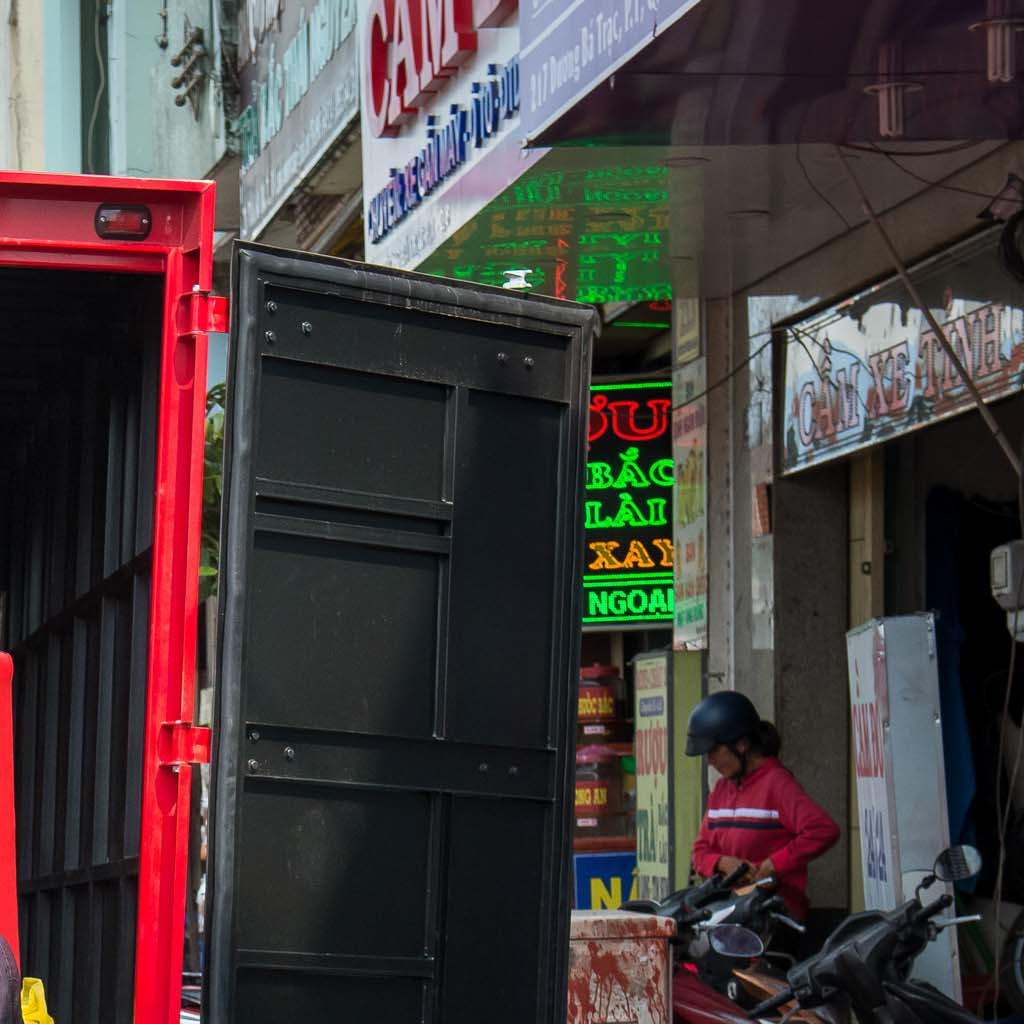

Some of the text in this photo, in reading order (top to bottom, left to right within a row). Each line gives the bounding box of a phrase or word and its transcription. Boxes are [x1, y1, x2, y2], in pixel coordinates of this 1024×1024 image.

[869, 341, 910, 418] XE
[584, 492, 667, 529] LÀI
[636, 720, 668, 789] RƯỢU
